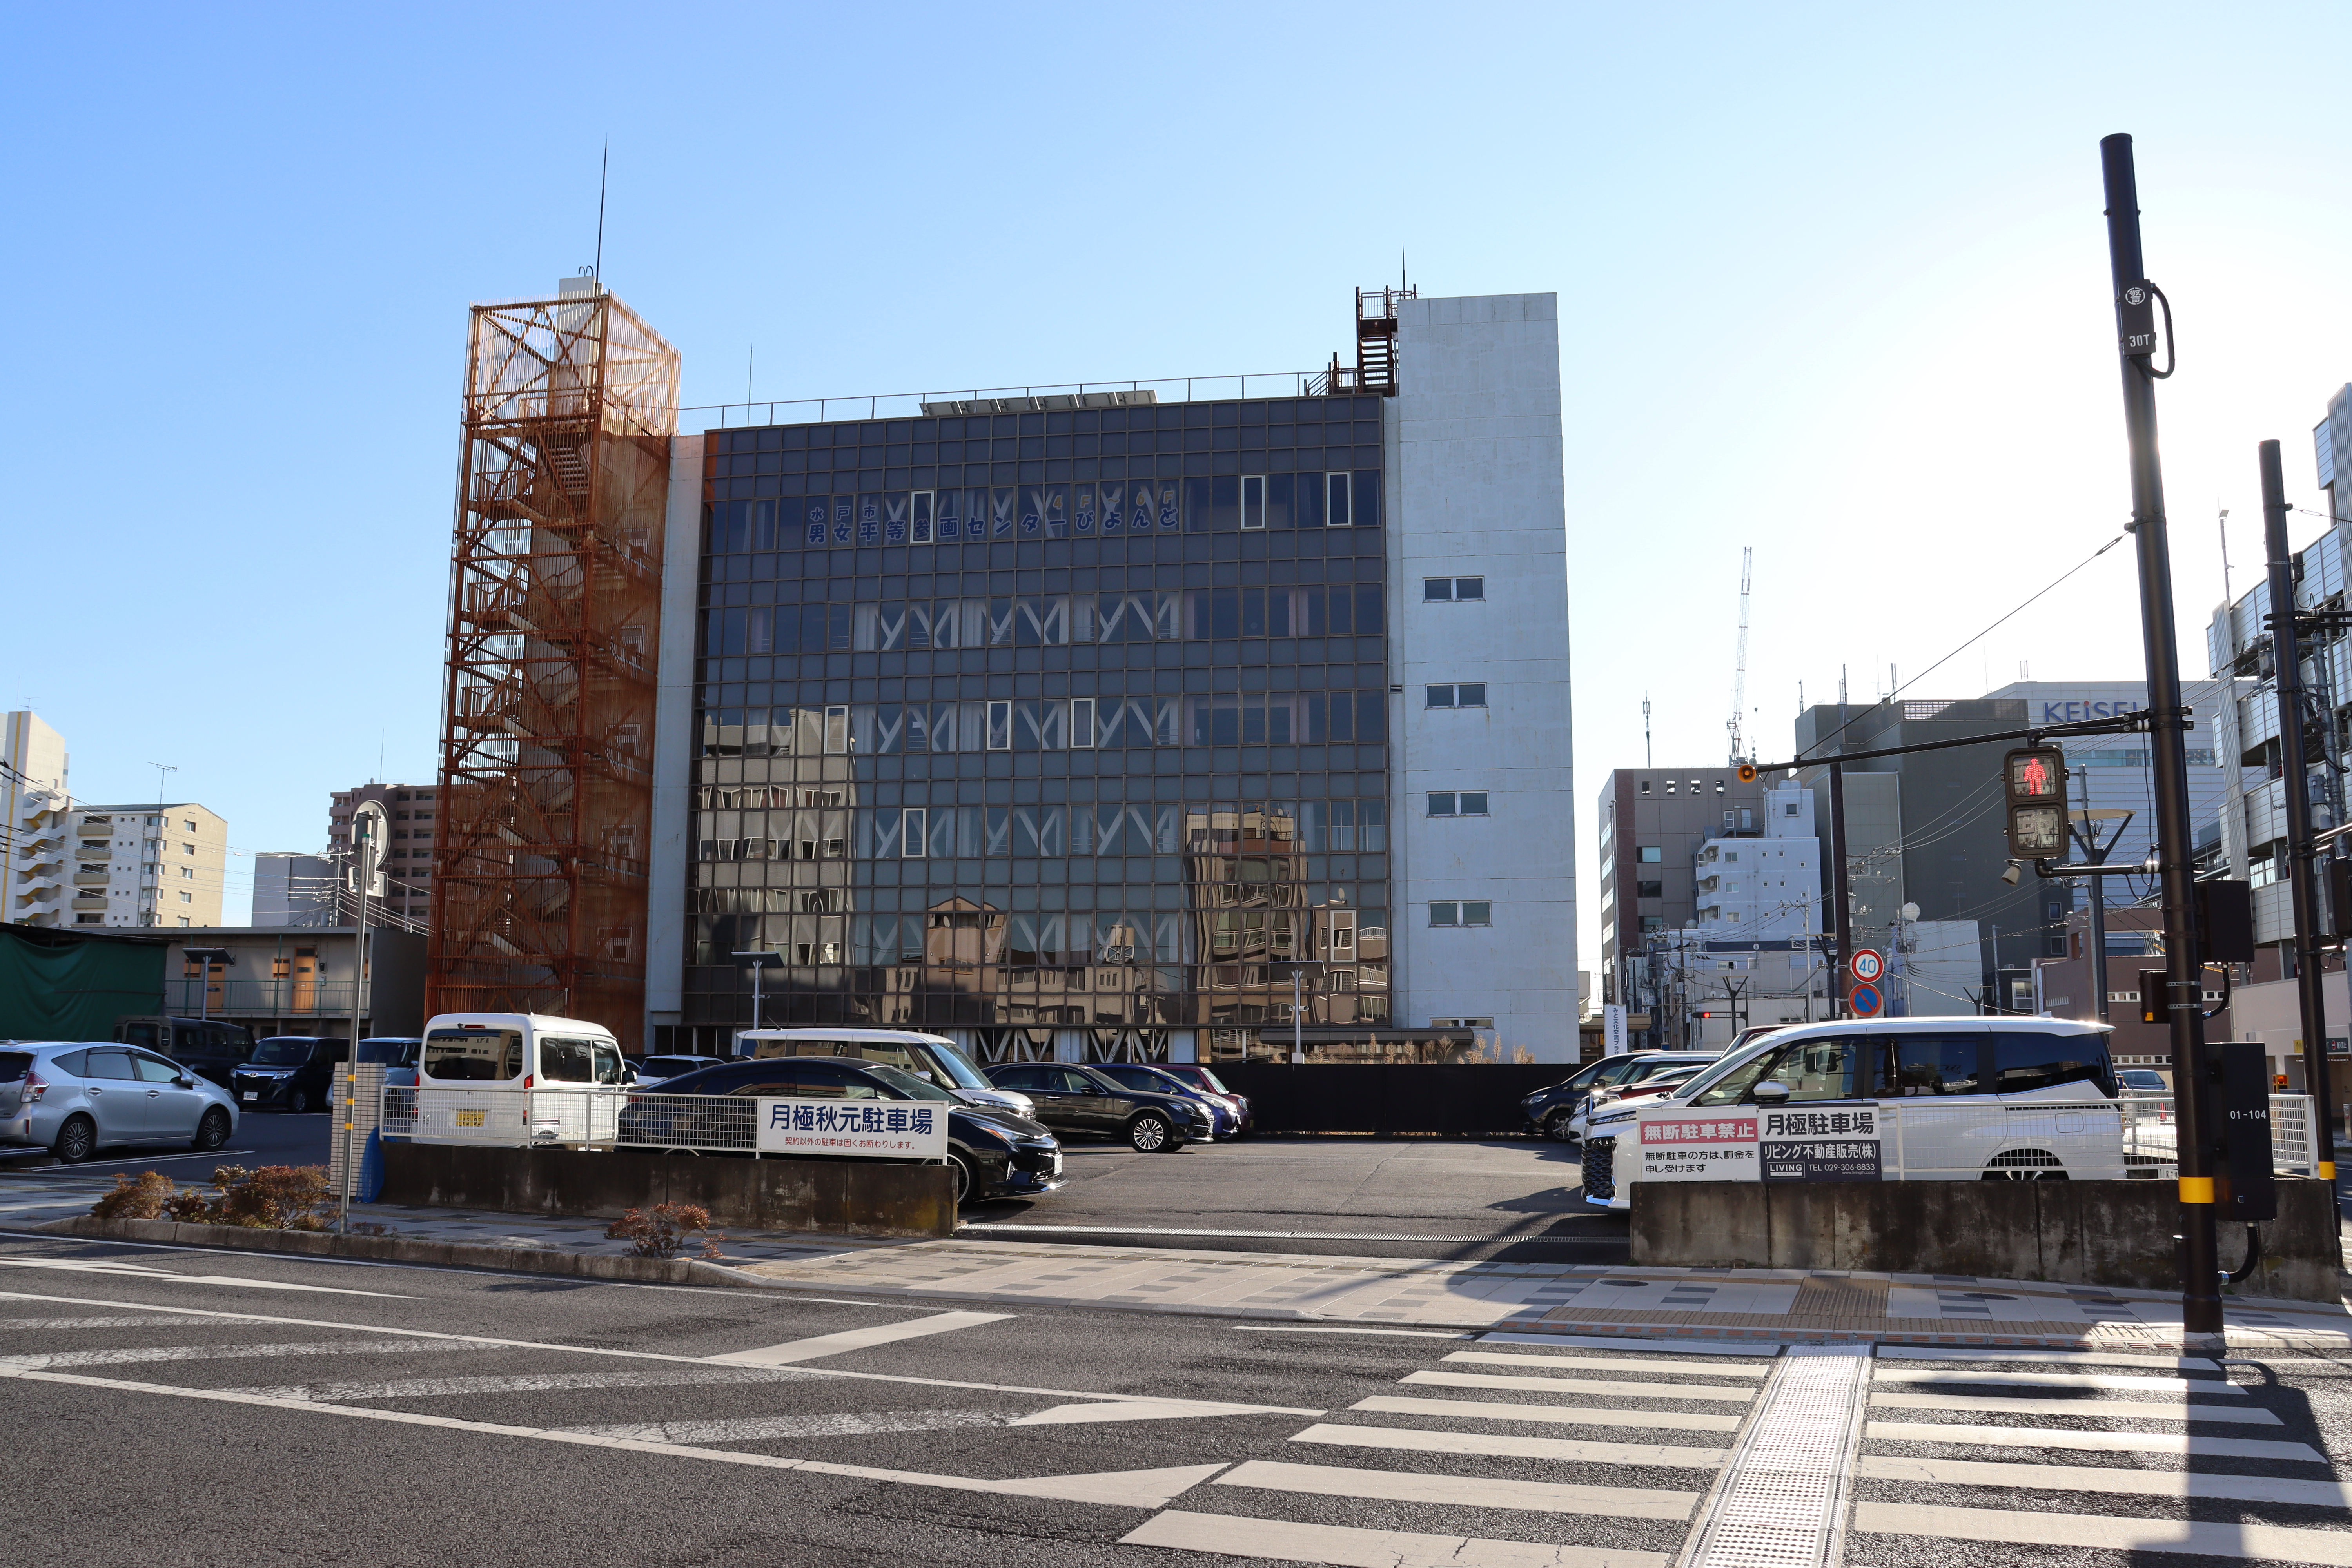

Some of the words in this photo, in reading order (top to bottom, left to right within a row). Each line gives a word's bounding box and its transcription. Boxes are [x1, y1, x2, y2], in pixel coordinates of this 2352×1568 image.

[2129, 334, 2150, 347] 30T
[810, 504, 876, 522] 水戸市
[808, 507, 1178, 544] 男女平等参画センターびよんど
[1859, 958, 1876, 973] 40
[770, 1105, 933, 1135] 月極秋元駐車場
[2230, 1110, 2266, 1120] 01-104
[1644, 1122, 1755, 1140] 無断駐車禁止
[1765, 1112, 1874, 1136] 月極駐車場
[785, 1136, 915, 1150] 契約以外の駐車は固くお断わりします。
[1645, 1150, 1755, 1161] 無断駐車の方は、罰金を
[1764, 1143, 1877, 1160] リビング不動産販売(株)
[1645, 1163, 1706, 1174] 申し受けます
[1824, 1163, 1875, 1171] 029-306-8833
